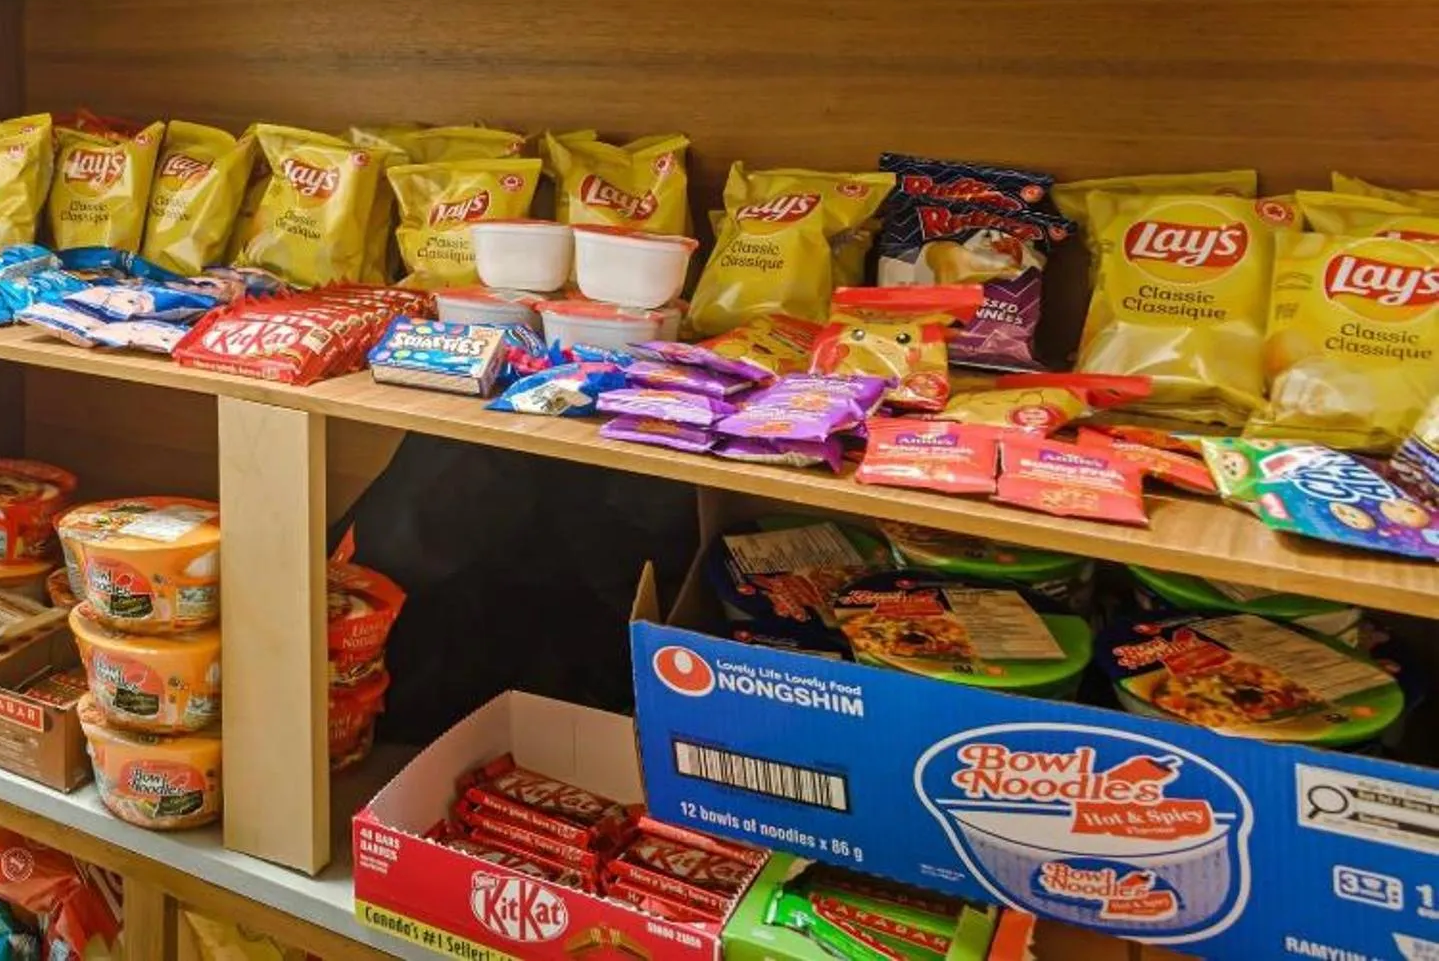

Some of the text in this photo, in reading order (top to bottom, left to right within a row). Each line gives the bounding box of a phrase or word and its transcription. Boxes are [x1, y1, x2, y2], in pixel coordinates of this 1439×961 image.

[68, 150, 127, 189] Lay's
[585, 177, 651, 216] Lay's
[1130, 220, 1249, 268] Lay's
[1138, 285, 1216, 305] Classic
[1329, 255, 1439, 307] Lay's
[1122, 297, 1227, 322] Classique
[205, 323, 297, 355] KitKat
[391, 331, 486, 357] SMARTIES
[1324, 336, 1433, 362] Classique
[1339, 323, 1420, 345] Classic
[716, 659, 862, 696] Lovely Life Lovely Food
[718, 672, 864, 718] NONGSHIM
[958, 743, 1095, 777] Bowl
[952, 770, 1160, 802] Noodles
[680, 801, 864, 862] 12 bowls of noodles x 86 g
[1083, 808, 1204, 829] Hot & Spicy
[1040, 876, 1150, 898] Noodles
[1043, 862, 1116, 884] Bowl
[1340, 871, 1359, 893] 3
[483, 876, 562, 939] KitKat
[364, 906, 419, 939] Canada's
[422, 930, 442, 949] #1
